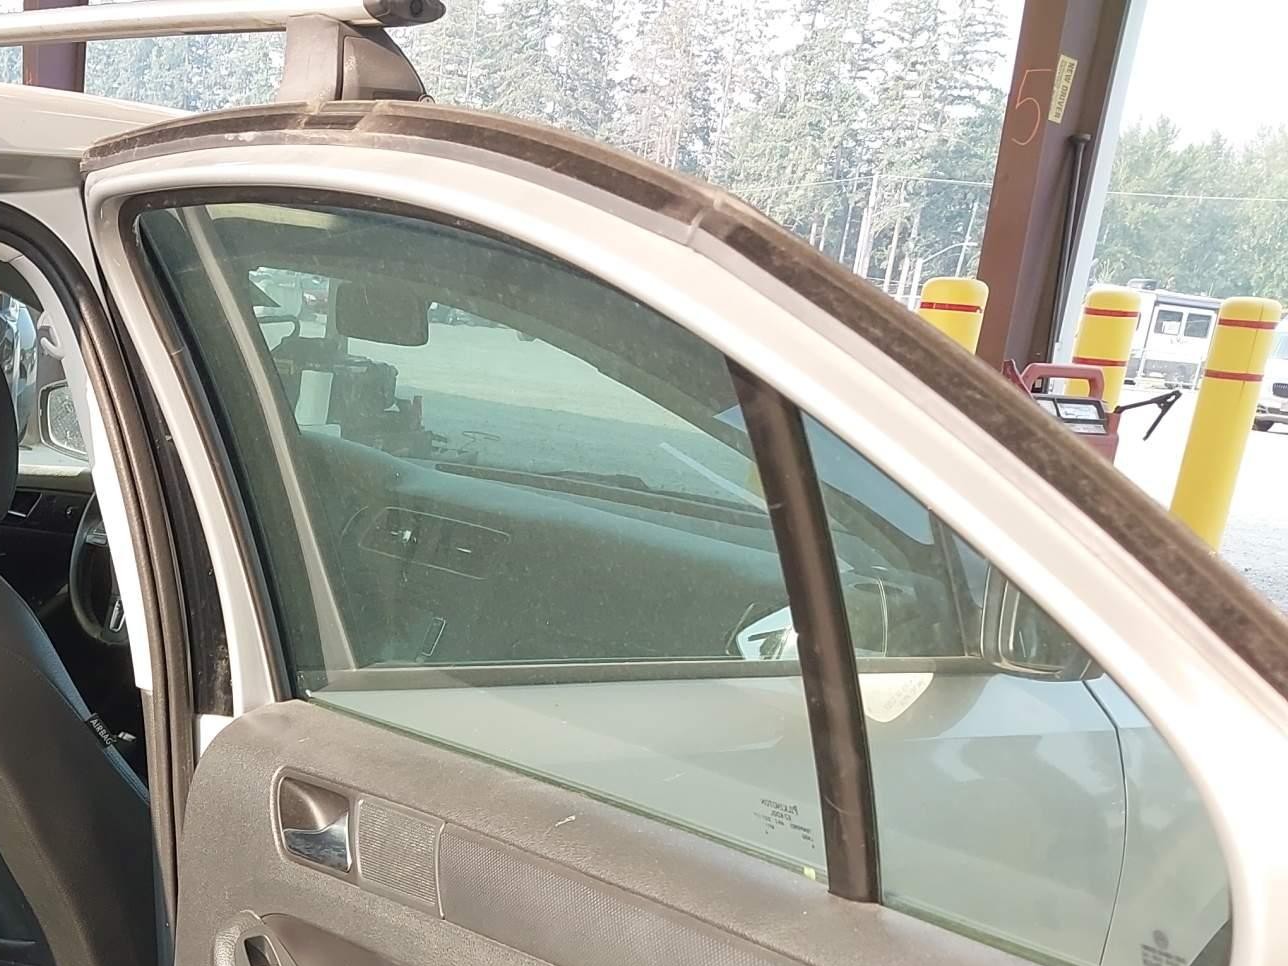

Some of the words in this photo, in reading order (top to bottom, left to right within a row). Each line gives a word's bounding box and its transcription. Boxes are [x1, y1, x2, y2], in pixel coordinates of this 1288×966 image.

[1064, 62, 1075, 84] NEW
[1011, 68, 1053, 146] 5
[1054, 84, 1069, 120] DRIVER
[89, 718, 113, 745] AIRBAG
